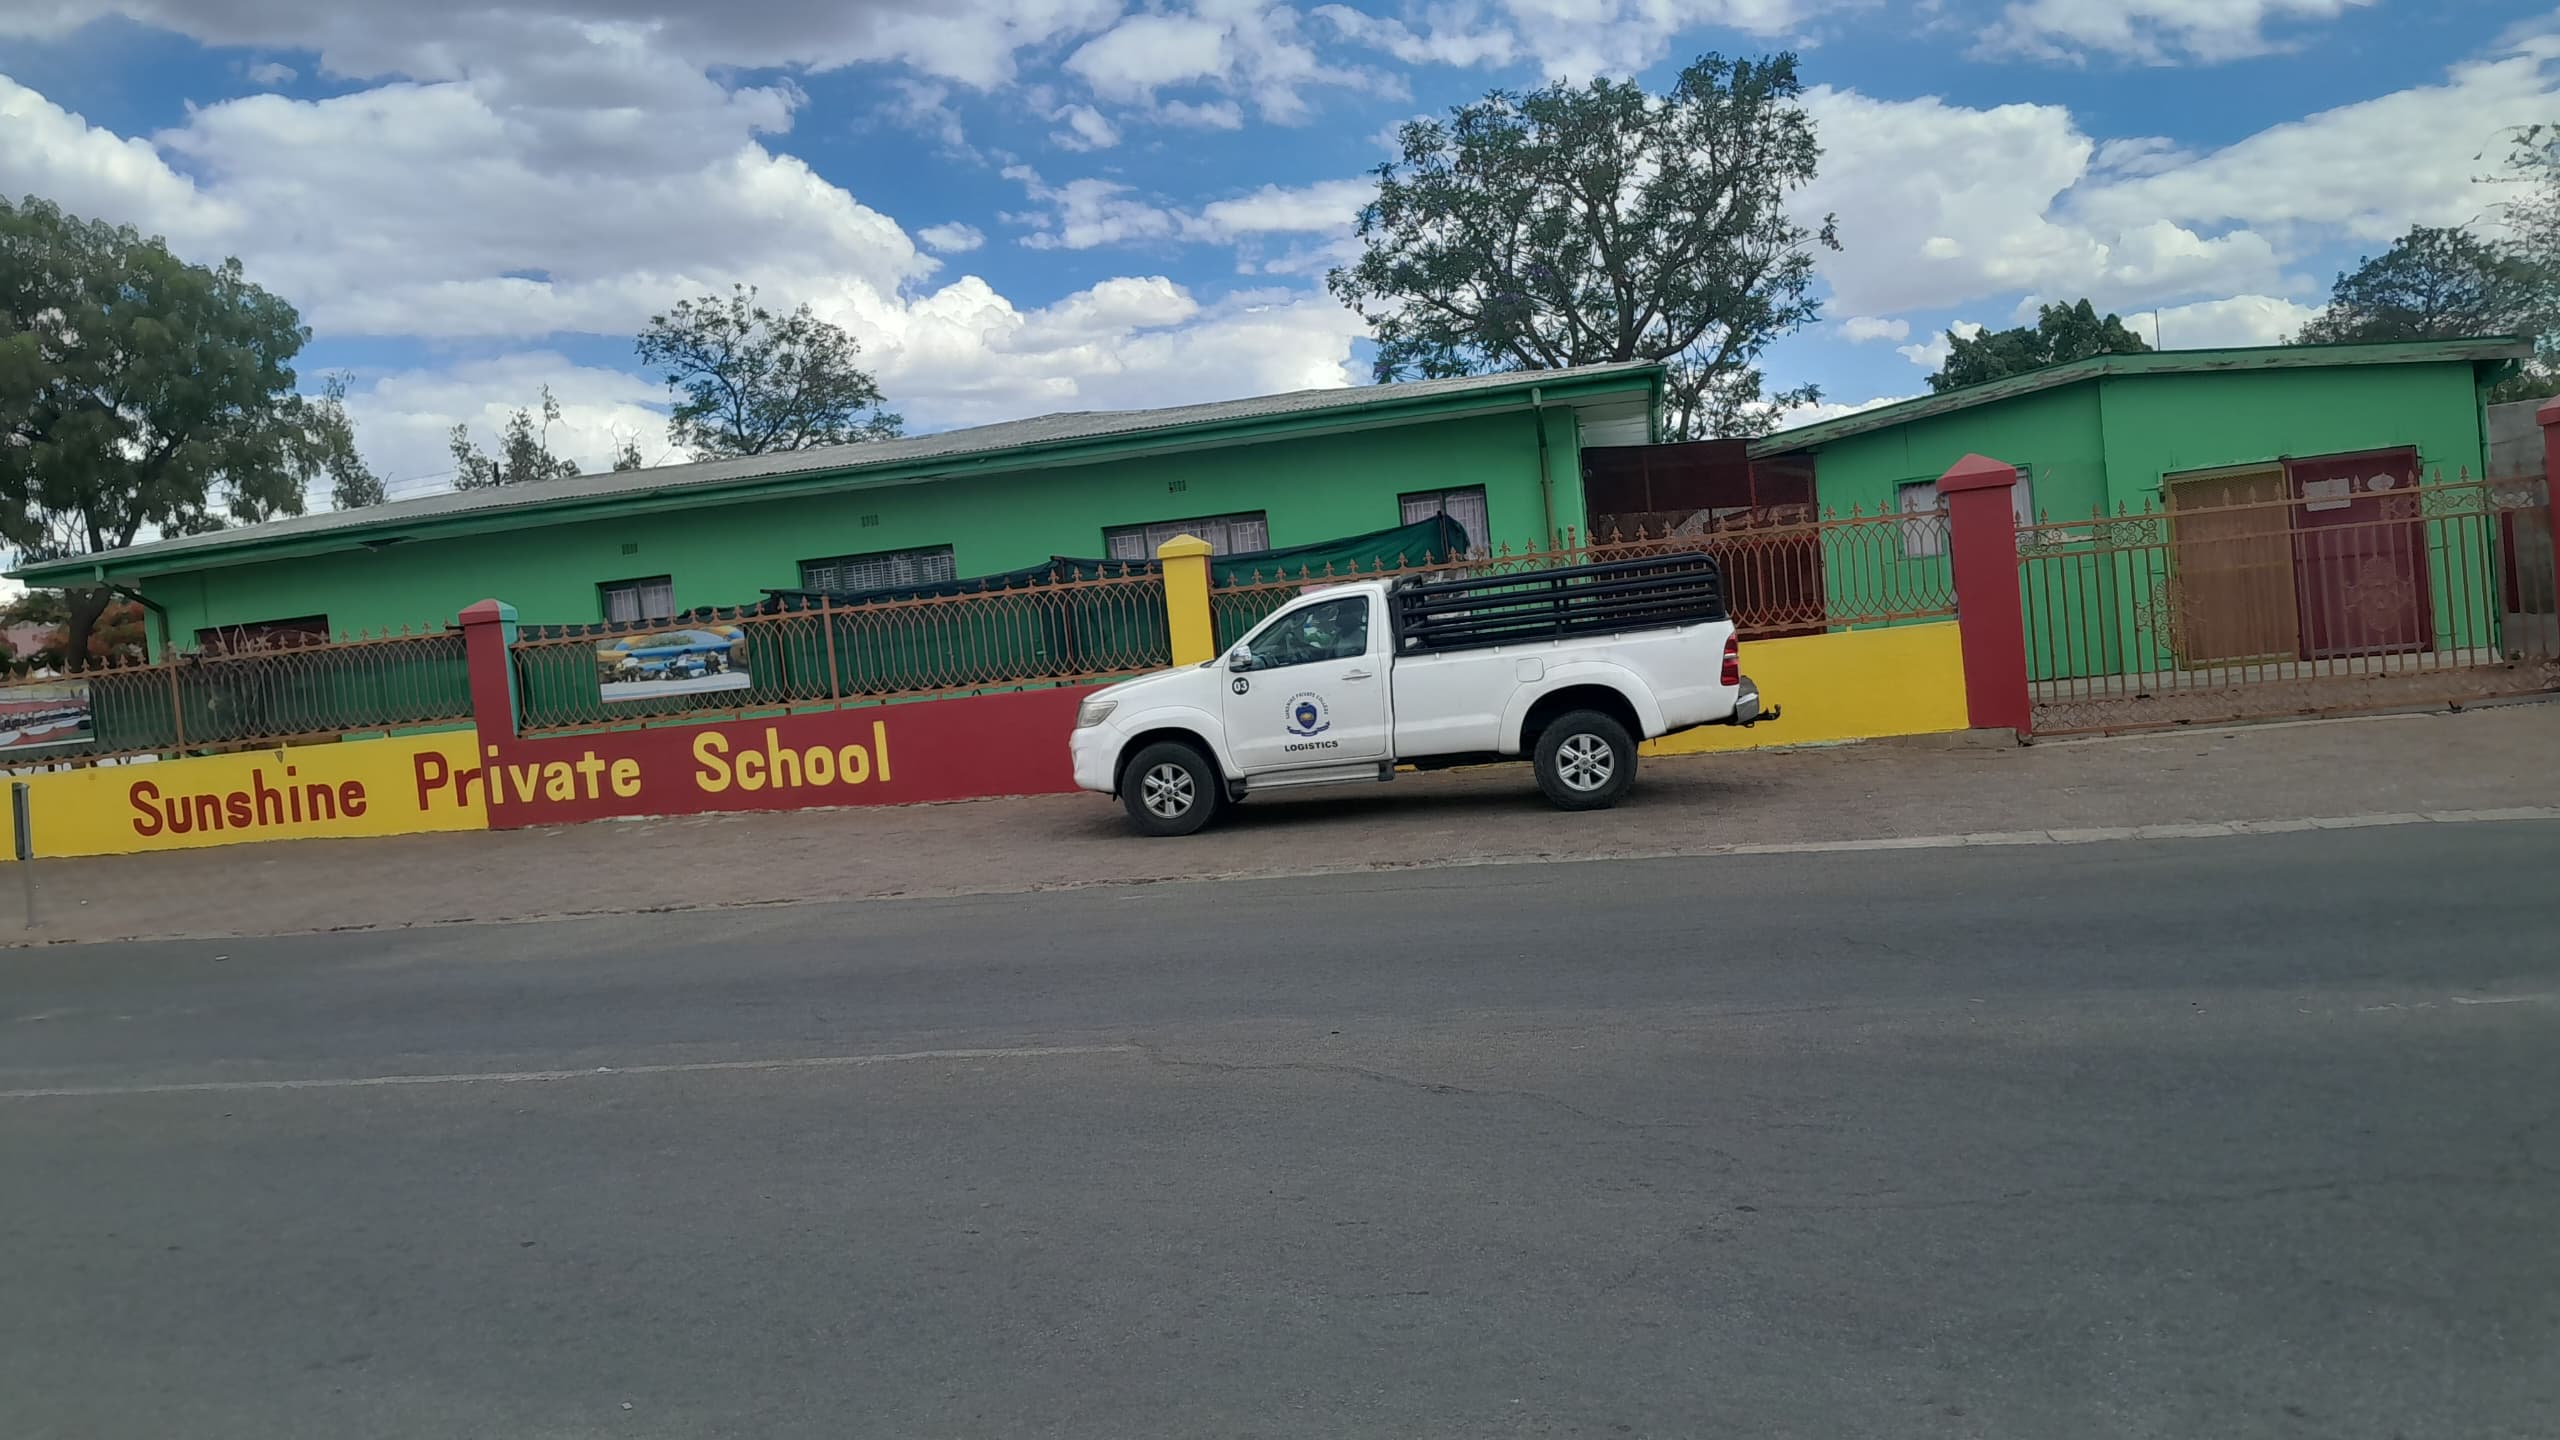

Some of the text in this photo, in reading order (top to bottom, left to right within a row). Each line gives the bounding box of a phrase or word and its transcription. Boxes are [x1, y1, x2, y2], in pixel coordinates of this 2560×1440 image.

[1234, 680, 1247, 692] 03
[1284, 741, 1338, 752] LOGISTICS
[129, 720, 891, 837] Sunshine Private School
